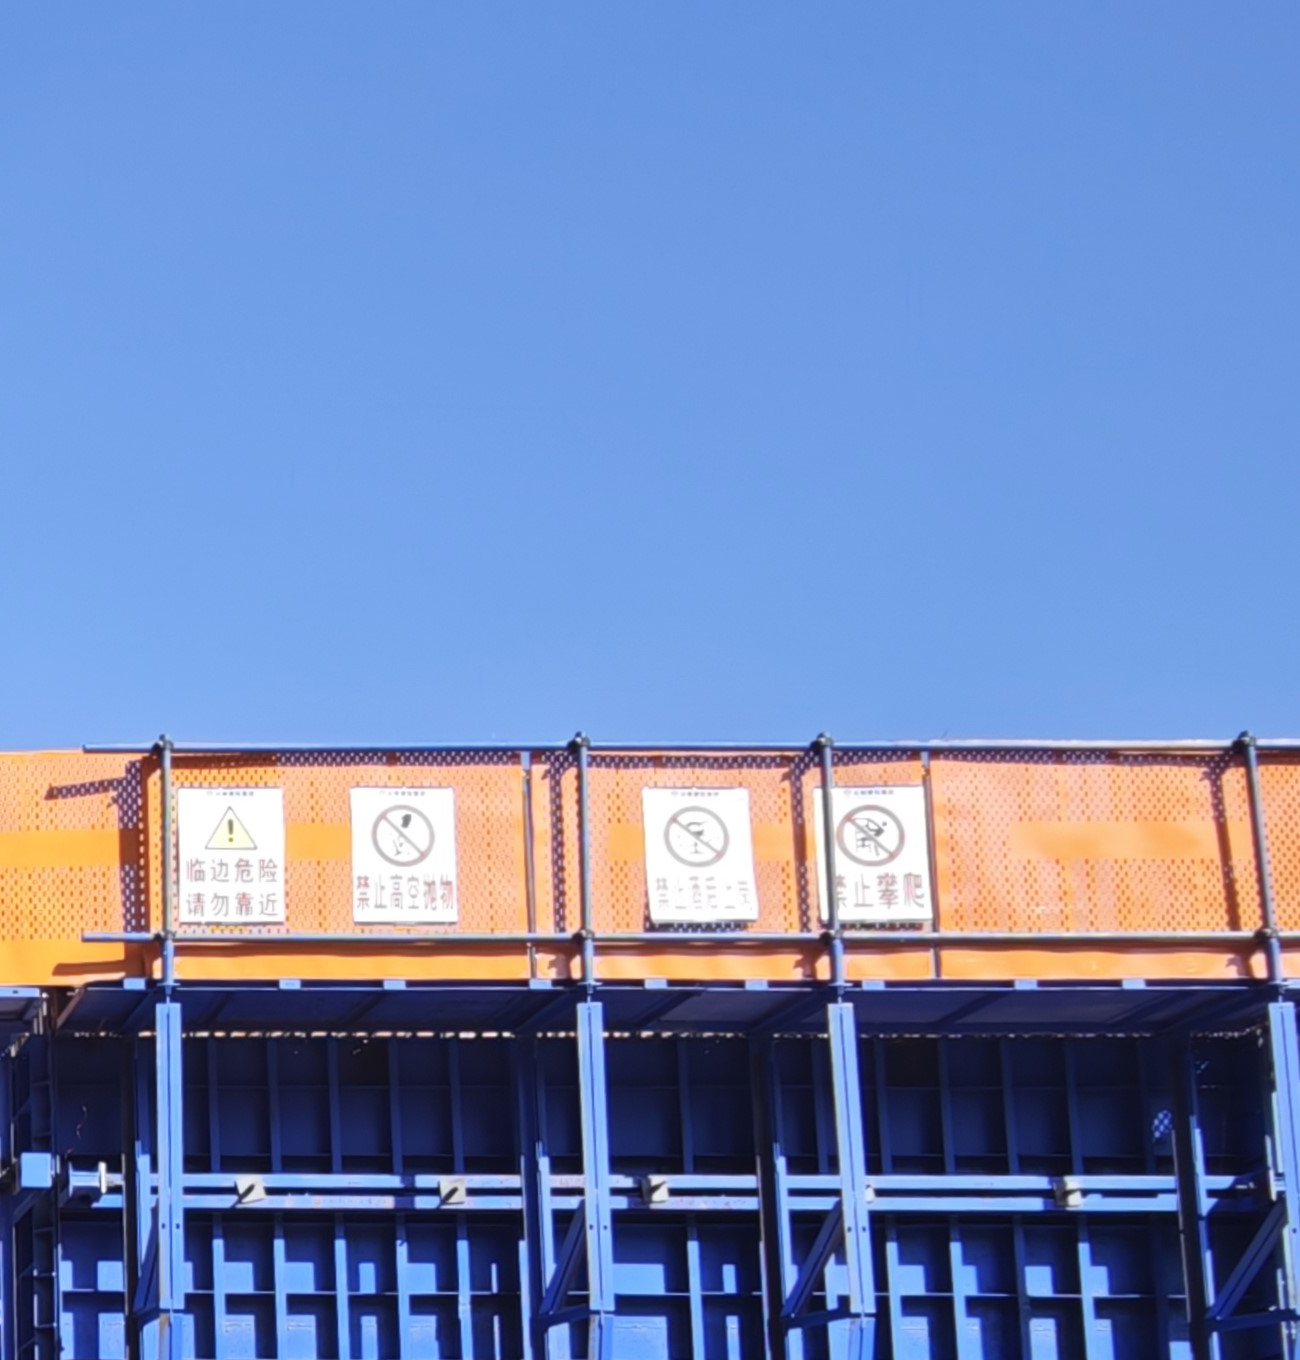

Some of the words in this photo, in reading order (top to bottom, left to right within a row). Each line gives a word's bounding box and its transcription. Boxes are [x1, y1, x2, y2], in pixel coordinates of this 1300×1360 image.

[186, 858, 278, 883] 临边危险
[186, 892, 278, 917] 请勿靠近
[357, 873, 454, 911] 禁止高空抛物
